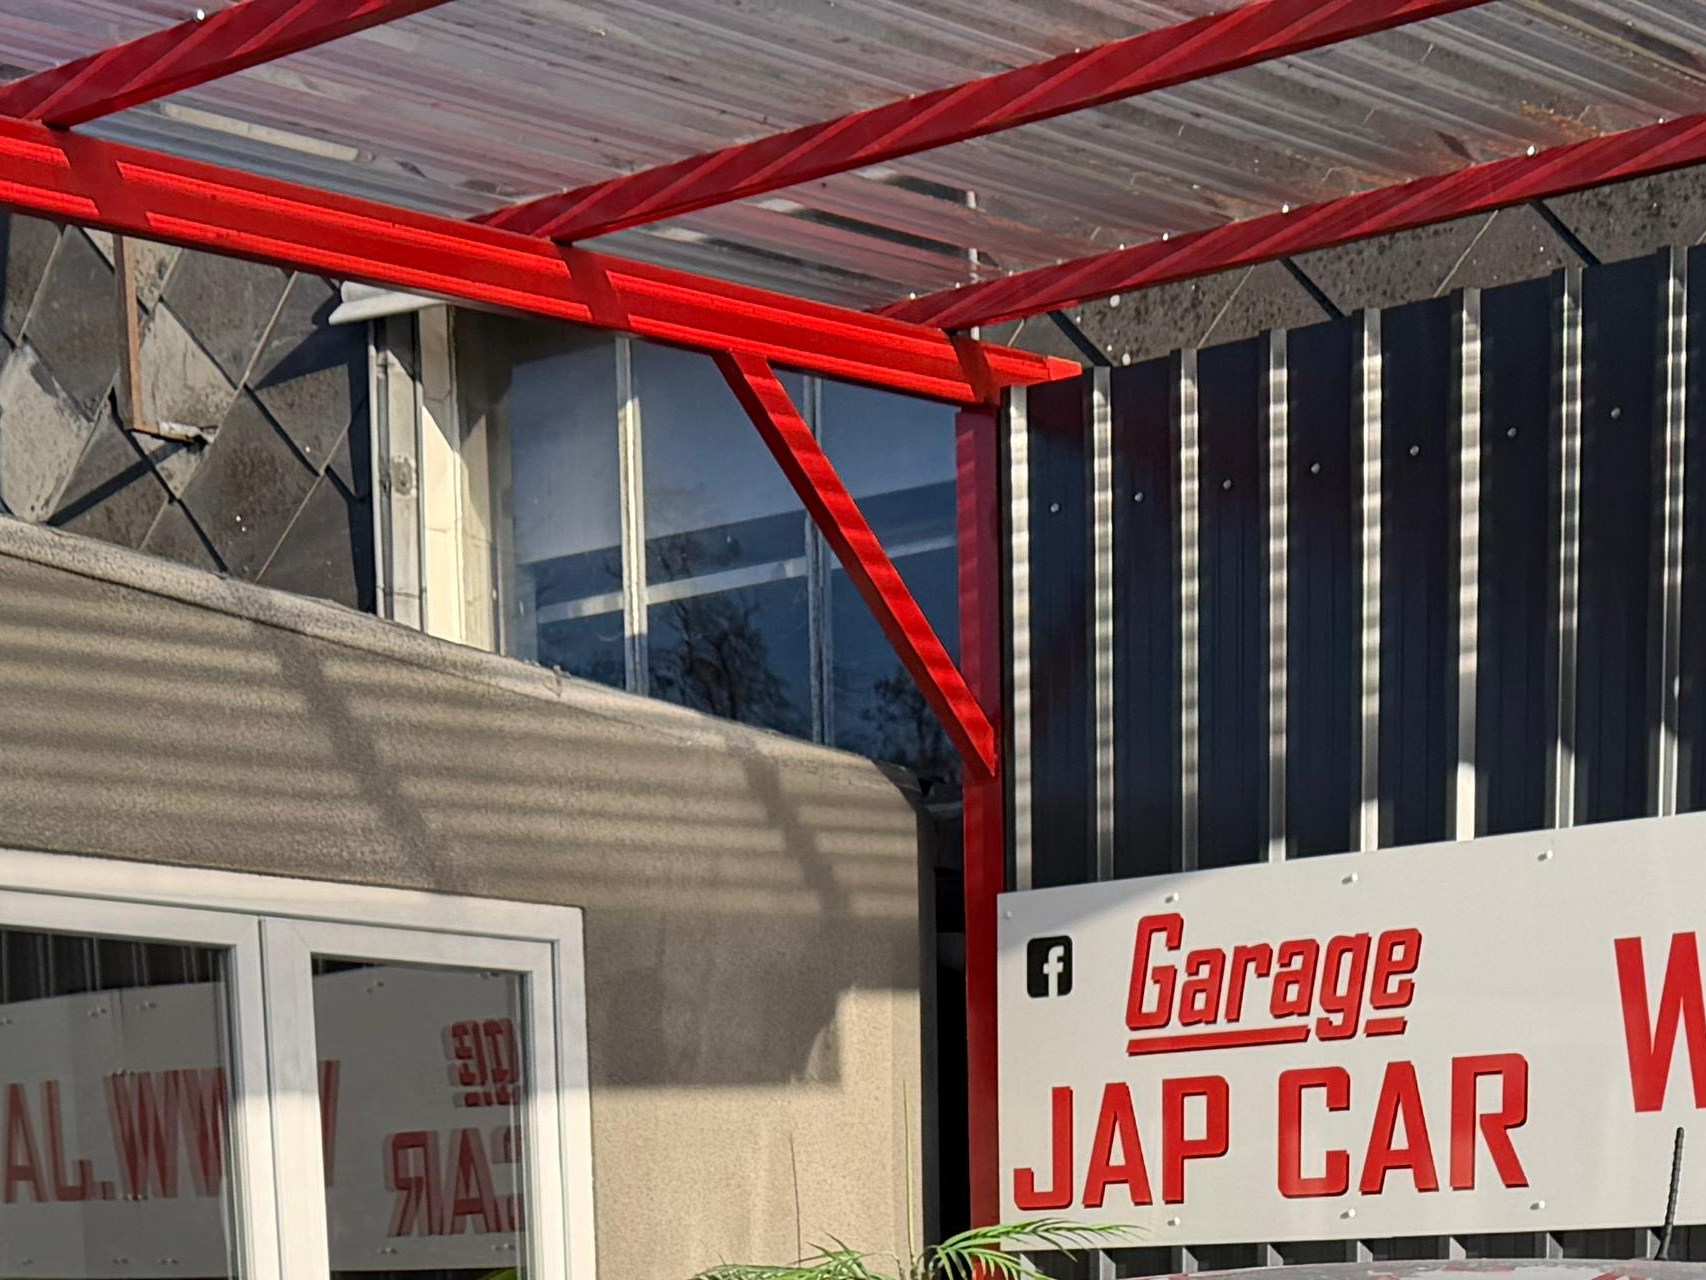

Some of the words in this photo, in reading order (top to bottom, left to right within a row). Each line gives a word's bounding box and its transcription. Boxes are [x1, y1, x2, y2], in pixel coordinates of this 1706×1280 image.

[1126, 912, 1421, 1052] Garage
[1014, 1076, 1228, 1211] JAP
[1278, 1052, 1532, 1199] CAR
